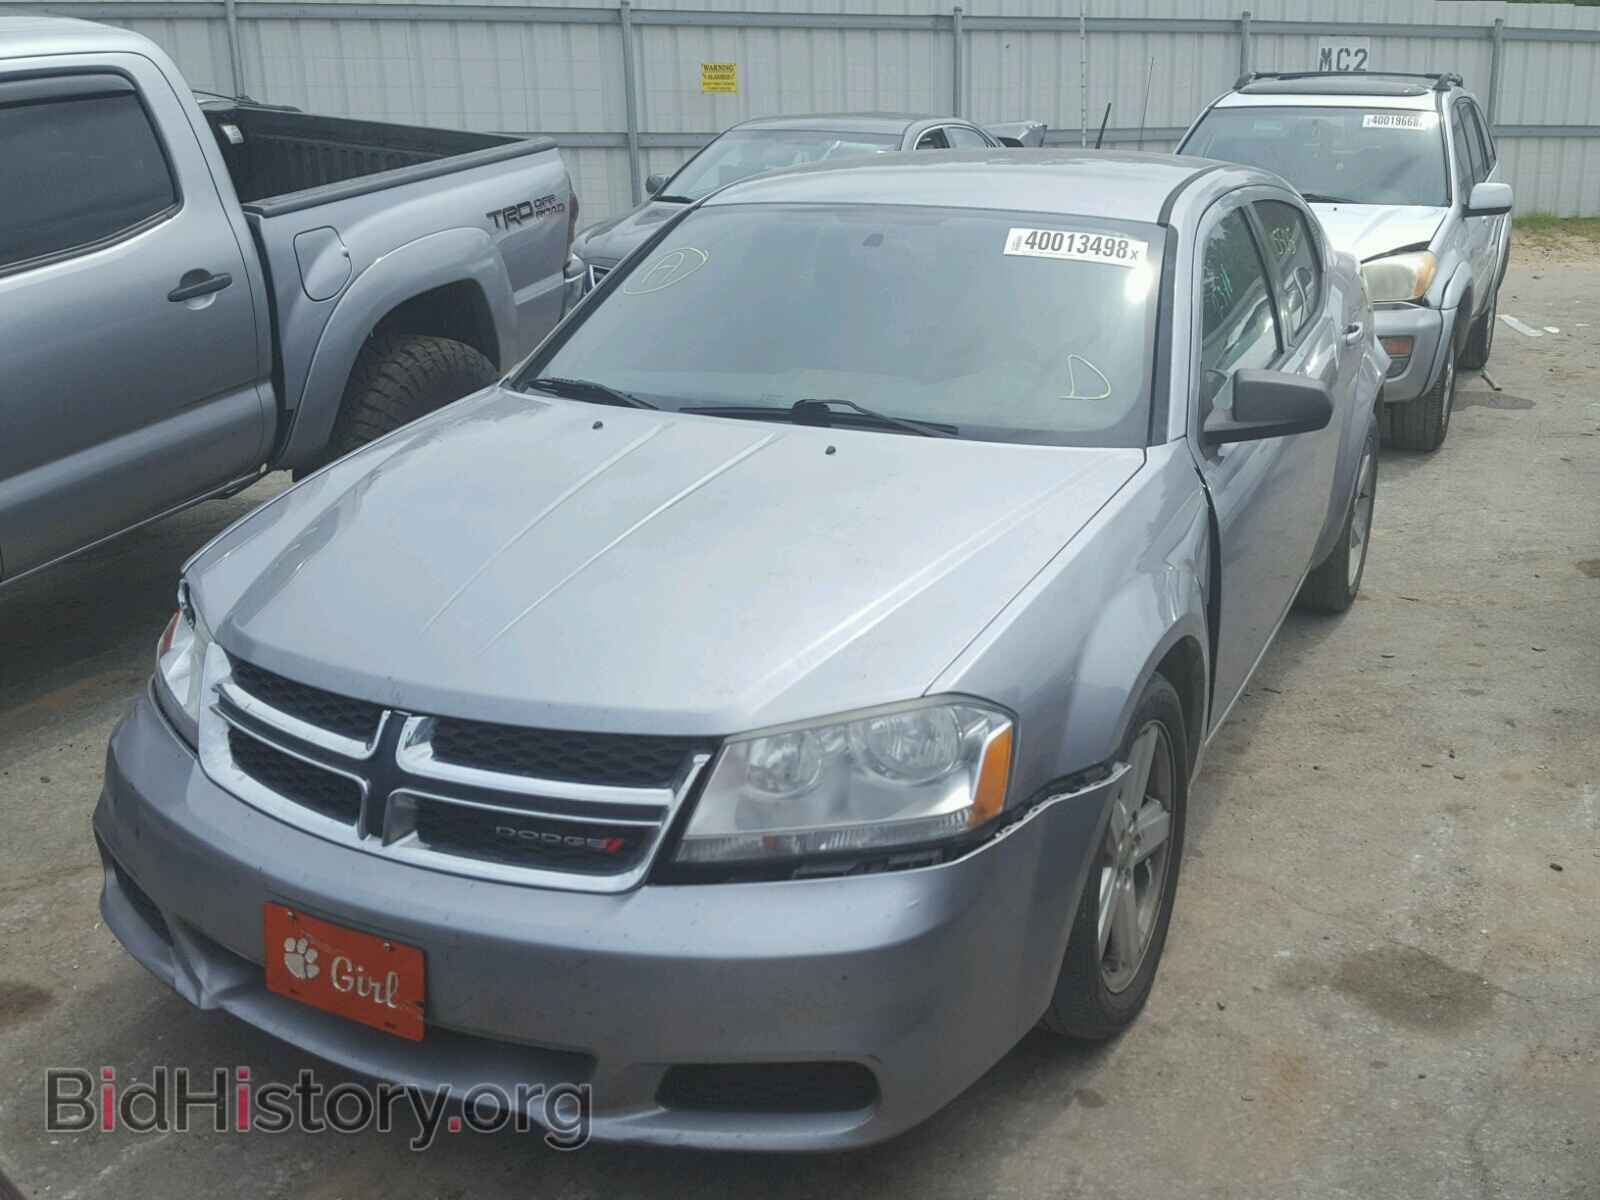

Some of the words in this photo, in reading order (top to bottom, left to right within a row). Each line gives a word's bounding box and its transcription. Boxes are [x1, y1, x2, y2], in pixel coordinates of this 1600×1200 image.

[703, 64, 734, 72] WARNING
[1319, 47, 1368, 72] MC2
[486, 201, 533, 230] TRD
[1024, 231, 1129, 259] 40013498
[496, 826, 608, 849] DODGE
[331, 956, 399, 1008] Girl
